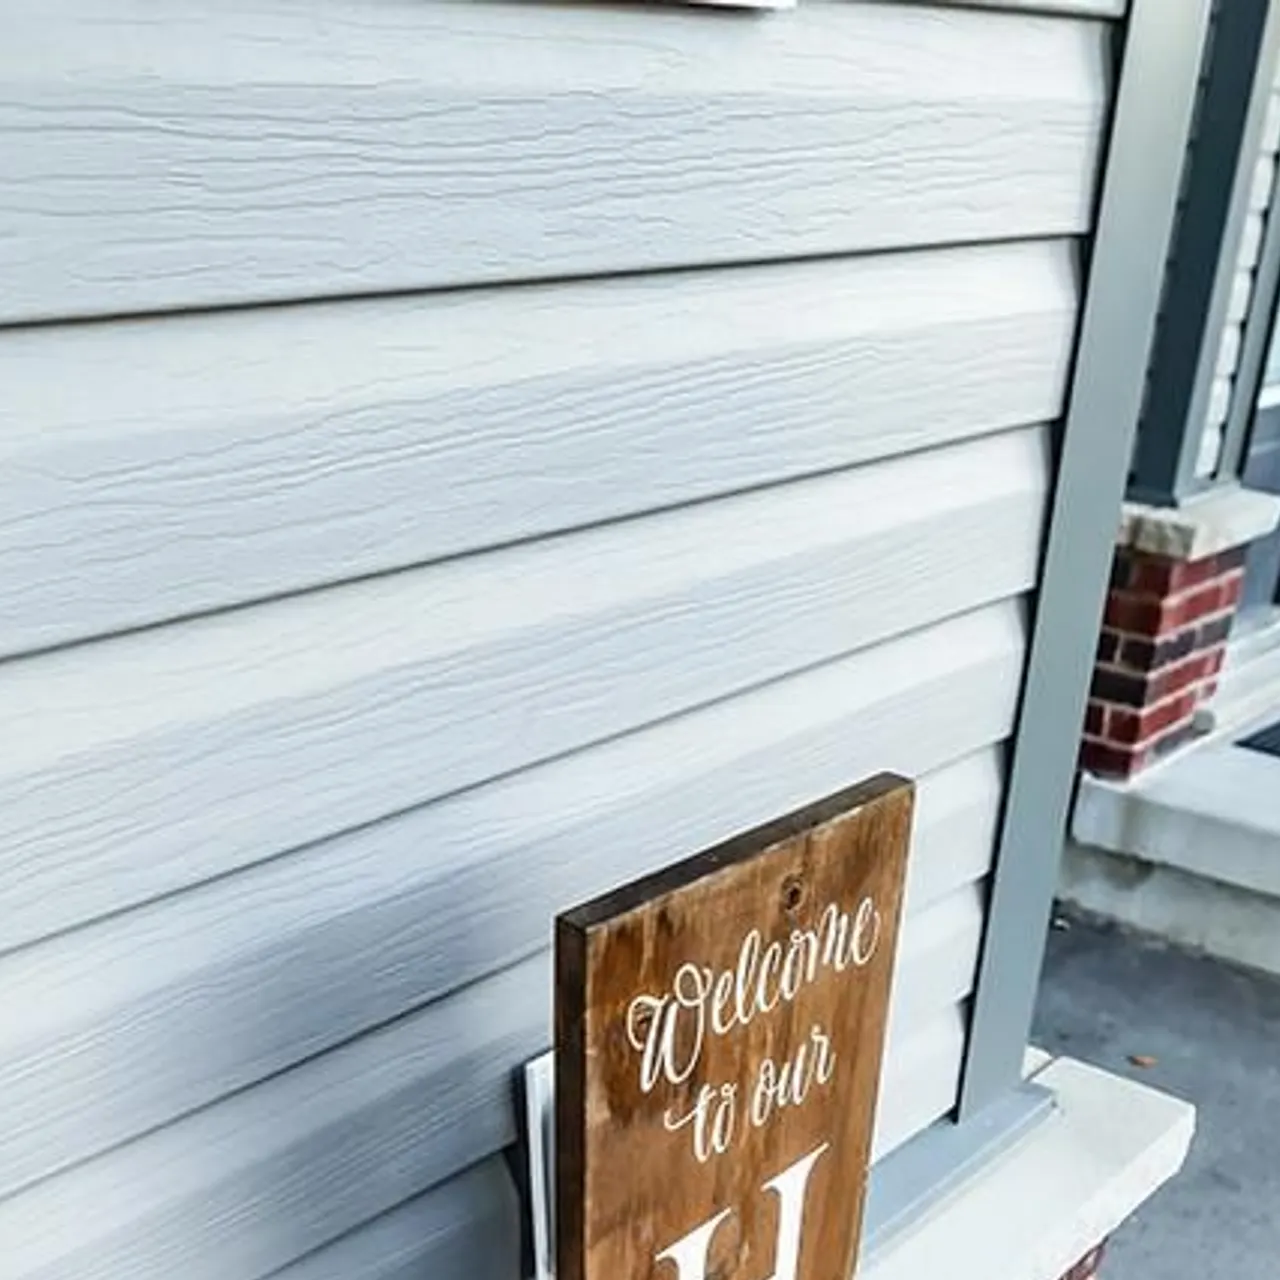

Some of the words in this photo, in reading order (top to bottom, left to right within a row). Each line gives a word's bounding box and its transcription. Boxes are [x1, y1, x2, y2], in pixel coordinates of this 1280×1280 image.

[628, 897, 880, 1092] Welcome
[664, 1083, 737, 1163] to
[751, 1025, 836, 1127] our
